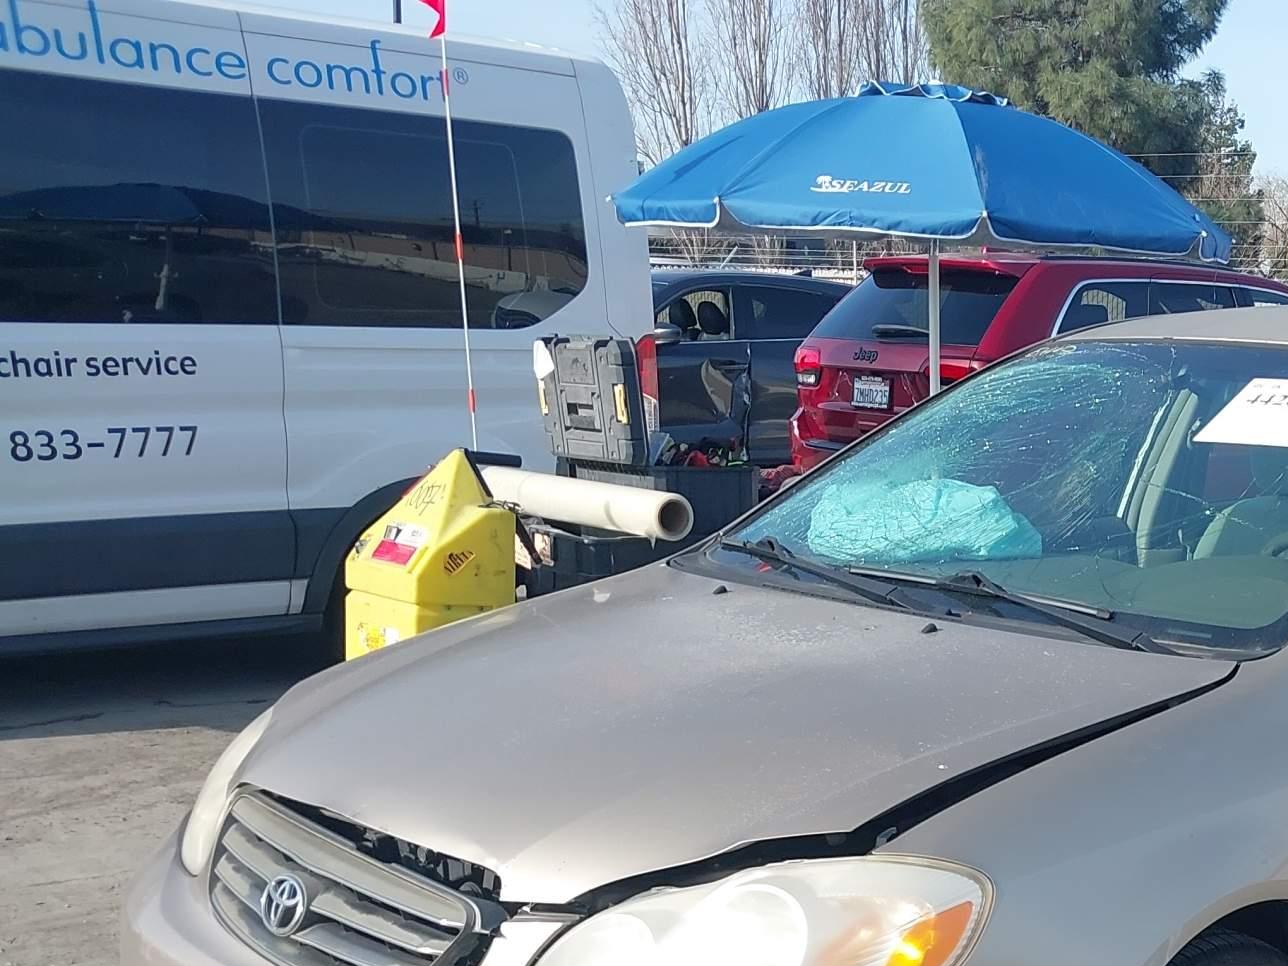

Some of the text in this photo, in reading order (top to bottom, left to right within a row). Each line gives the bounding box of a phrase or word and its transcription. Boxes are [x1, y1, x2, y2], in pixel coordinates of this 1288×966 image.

[0, 0, 247, 80] bulance
[831, 178, 912, 194] SEAZUL
[85, 350, 198, 377] service
[852, 347, 879, 364] Jeep
[9, 425, 198, 462] 833-7777
